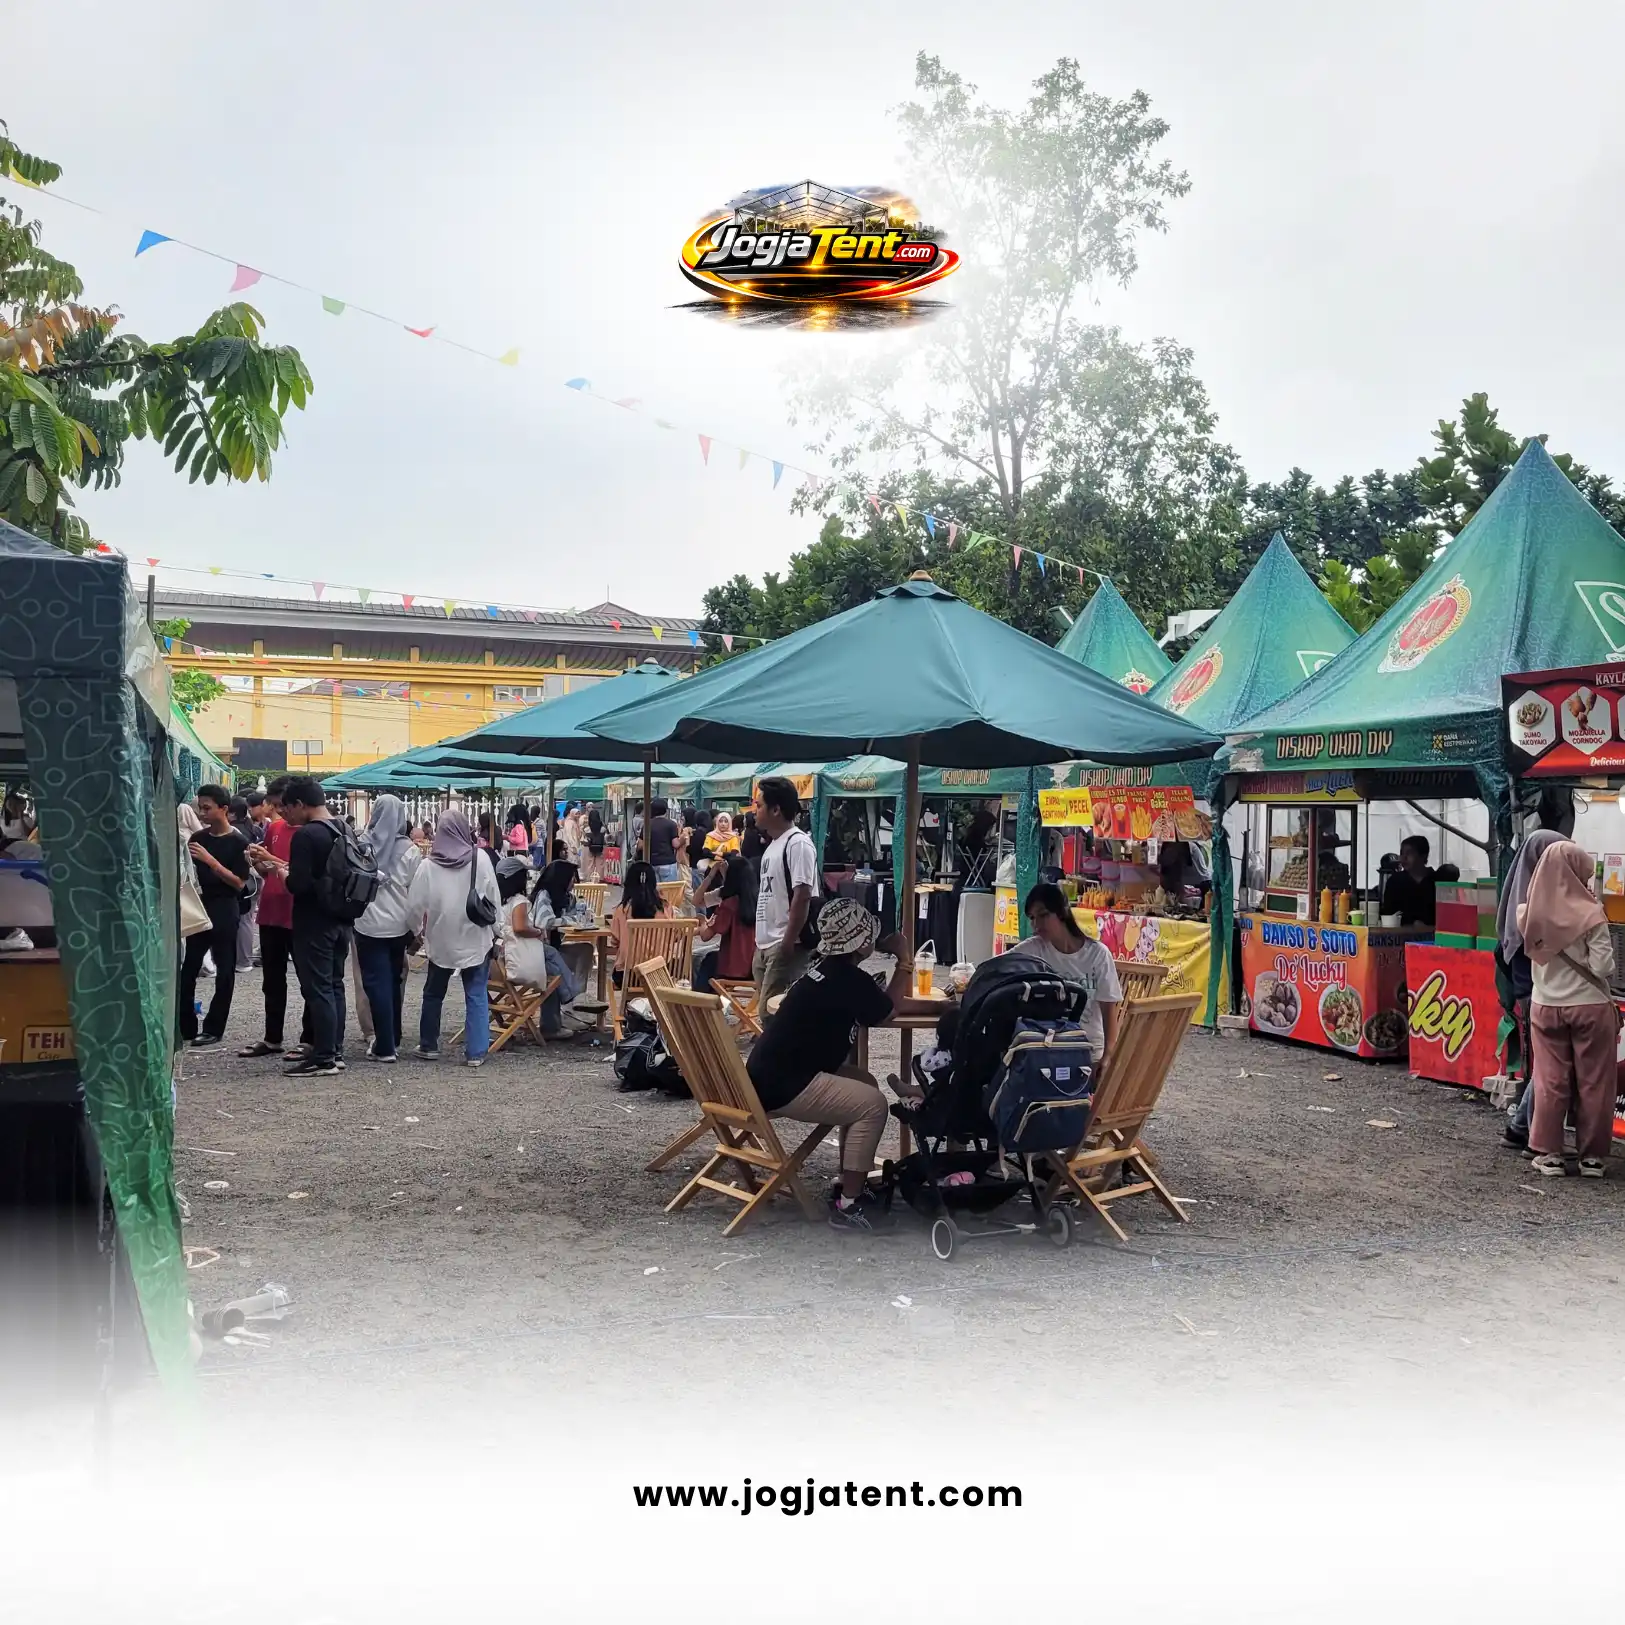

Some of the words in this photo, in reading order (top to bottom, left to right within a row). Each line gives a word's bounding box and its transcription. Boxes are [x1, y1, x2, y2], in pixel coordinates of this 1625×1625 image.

[1523, 731, 1542, 739] SUMO
[1568, 729, 1606, 737] MOZARELLA
[1366, 730, 1394, 755] DIY
[1136, 767, 1153, 787] DIY
[1069, 799, 1089, 814] PECEL
[1262, 921, 1305, 949] BAKSO
[1307, 926, 1318, 952] &
[1320, 928, 1358, 958] SOTO
[27, 1032, 65, 1049] TEH
